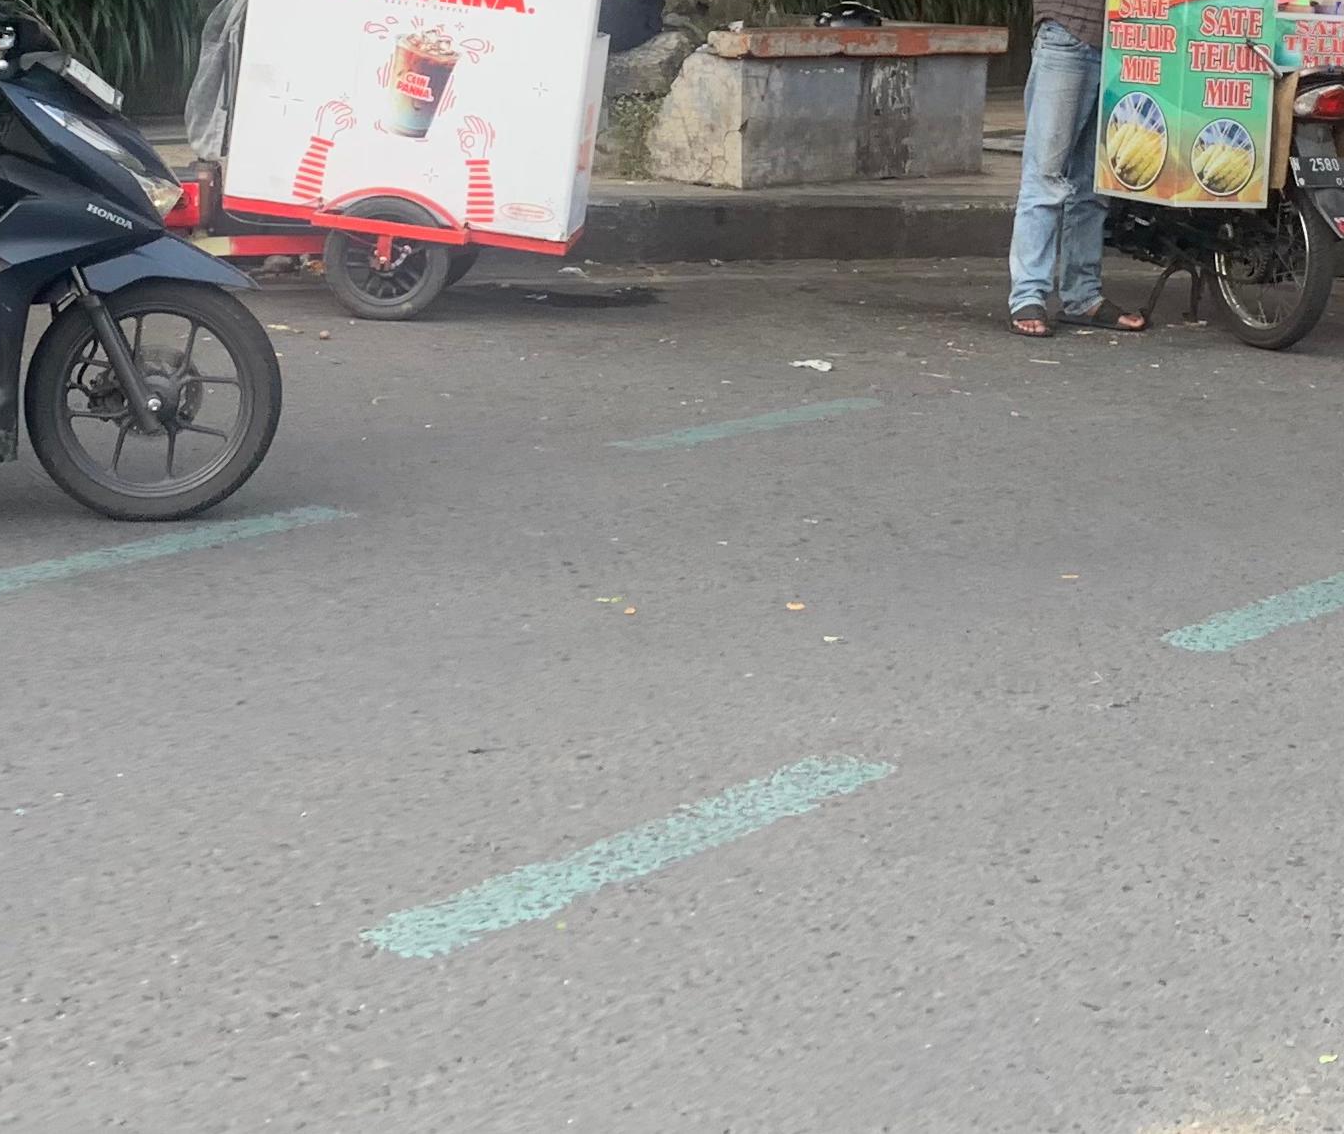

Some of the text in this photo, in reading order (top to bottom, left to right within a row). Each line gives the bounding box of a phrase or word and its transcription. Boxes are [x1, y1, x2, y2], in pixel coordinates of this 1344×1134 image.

[1109, 21, 1177, 53] TELUR
[1200, 5, 1263, 39] SATE
[1120, 55, 1161, 84] MIE
[1188, 40, 1272, 75] TELUR
[1203, 78, 1253, 109] MIE
[1309, 157, 1340, 172] 2580
[86, 202, 133, 230] HONDA
